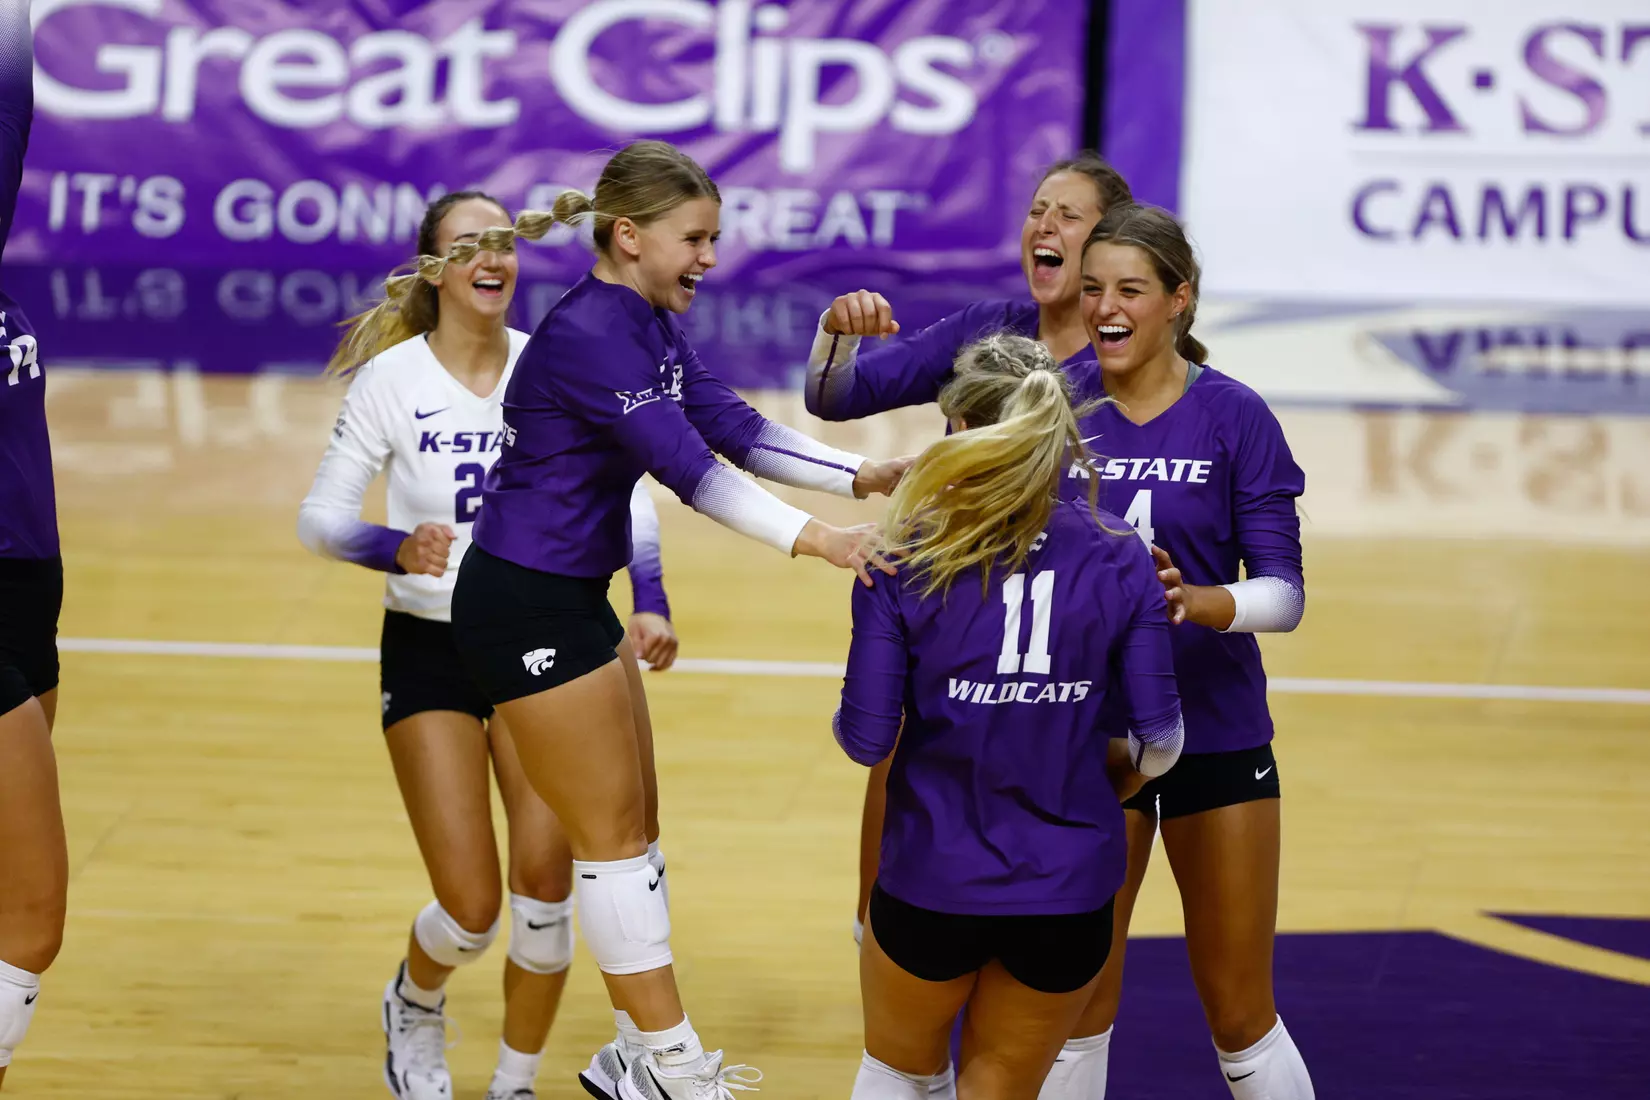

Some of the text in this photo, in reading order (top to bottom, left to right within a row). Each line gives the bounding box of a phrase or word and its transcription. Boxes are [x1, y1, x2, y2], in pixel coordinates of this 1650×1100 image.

[33, 0, 978, 173] Great Clips
[49, 171, 187, 239] IT'S
[213, 177, 449, 246] GONN
[718, 186, 896, 250] REAT
[1067, 457, 1213, 484] K-STATE
[1122, 489, 1155, 556] 4
[996, 570, 1055, 674] 11
[948, 677, 1093, 704] WILDCATS
